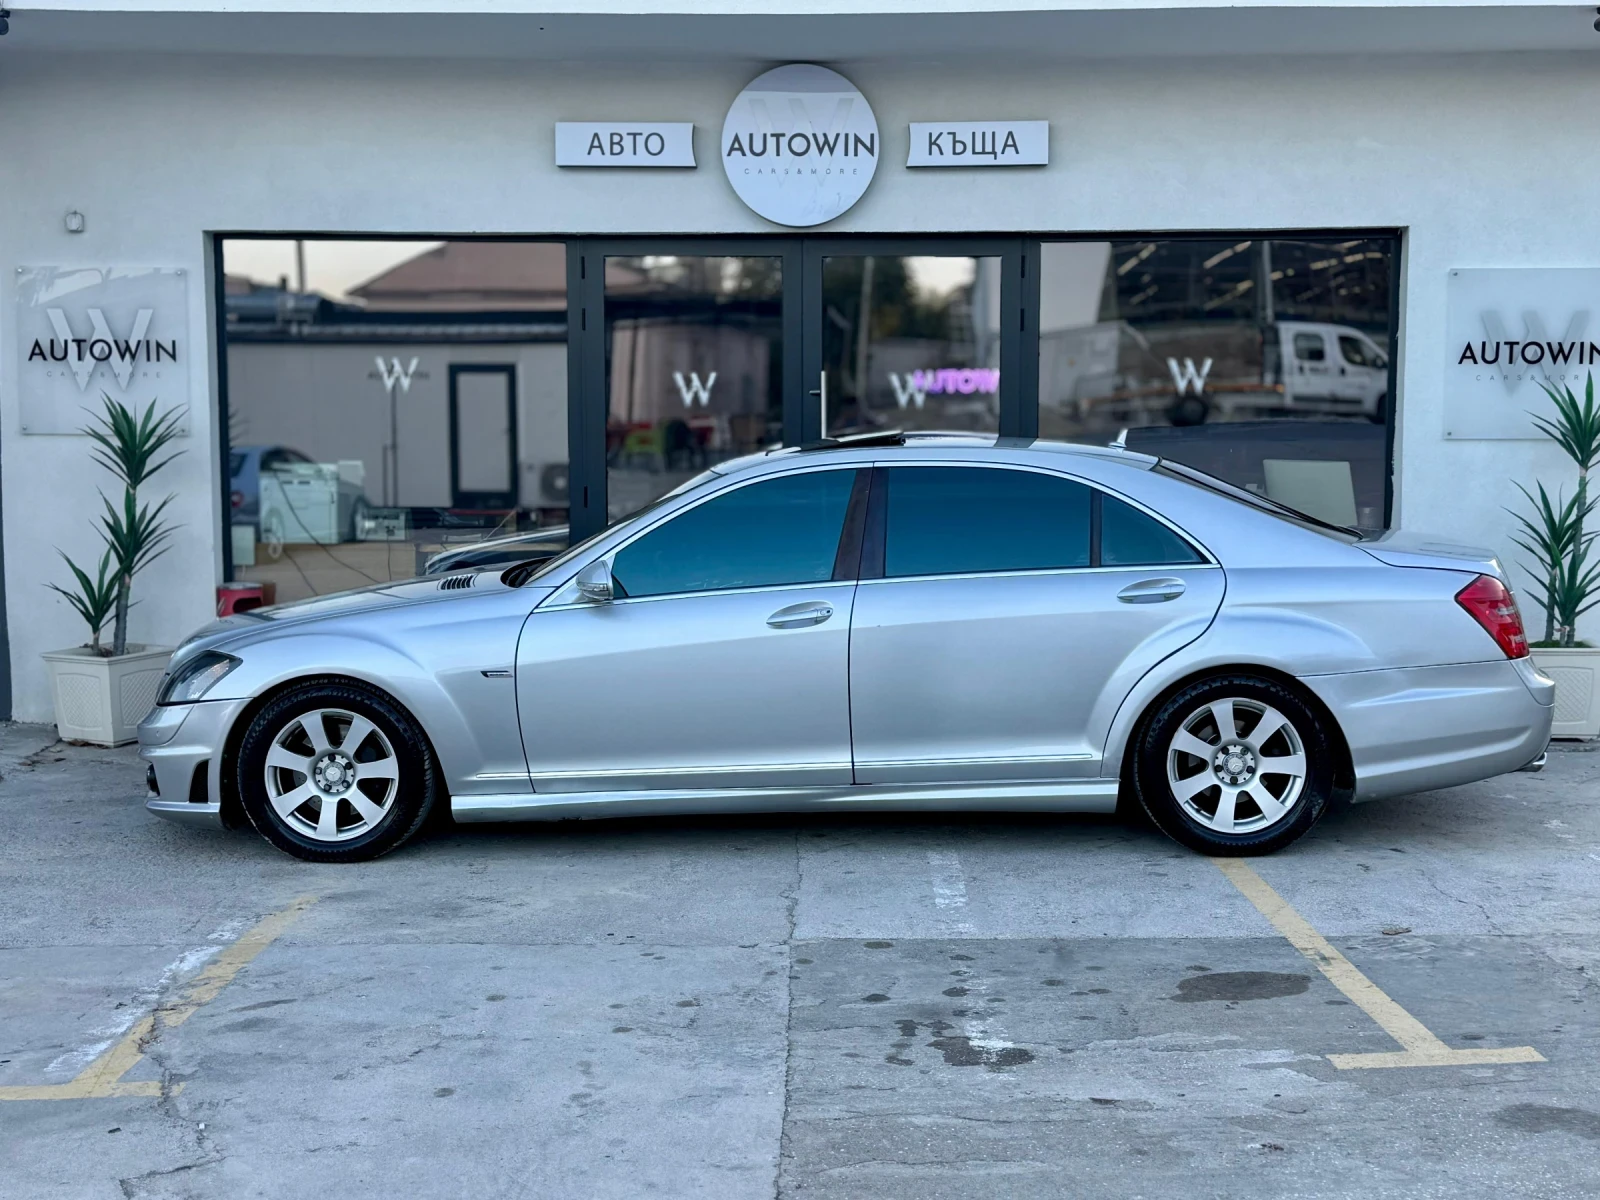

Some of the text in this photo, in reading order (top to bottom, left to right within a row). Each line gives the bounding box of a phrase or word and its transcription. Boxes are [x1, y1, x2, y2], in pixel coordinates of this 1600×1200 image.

[587, 132, 665, 157] АВТО
[726, 132, 875, 157] AUTOWIN
[927, 130, 1020, 159] КЪЩА
[28, 338, 177, 362] AUTOWIN
[46, 308, 154, 393] W
[375, 356, 420, 394] W
[672, 371, 718, 407] W
[1166, 356, 1213, 397] W
